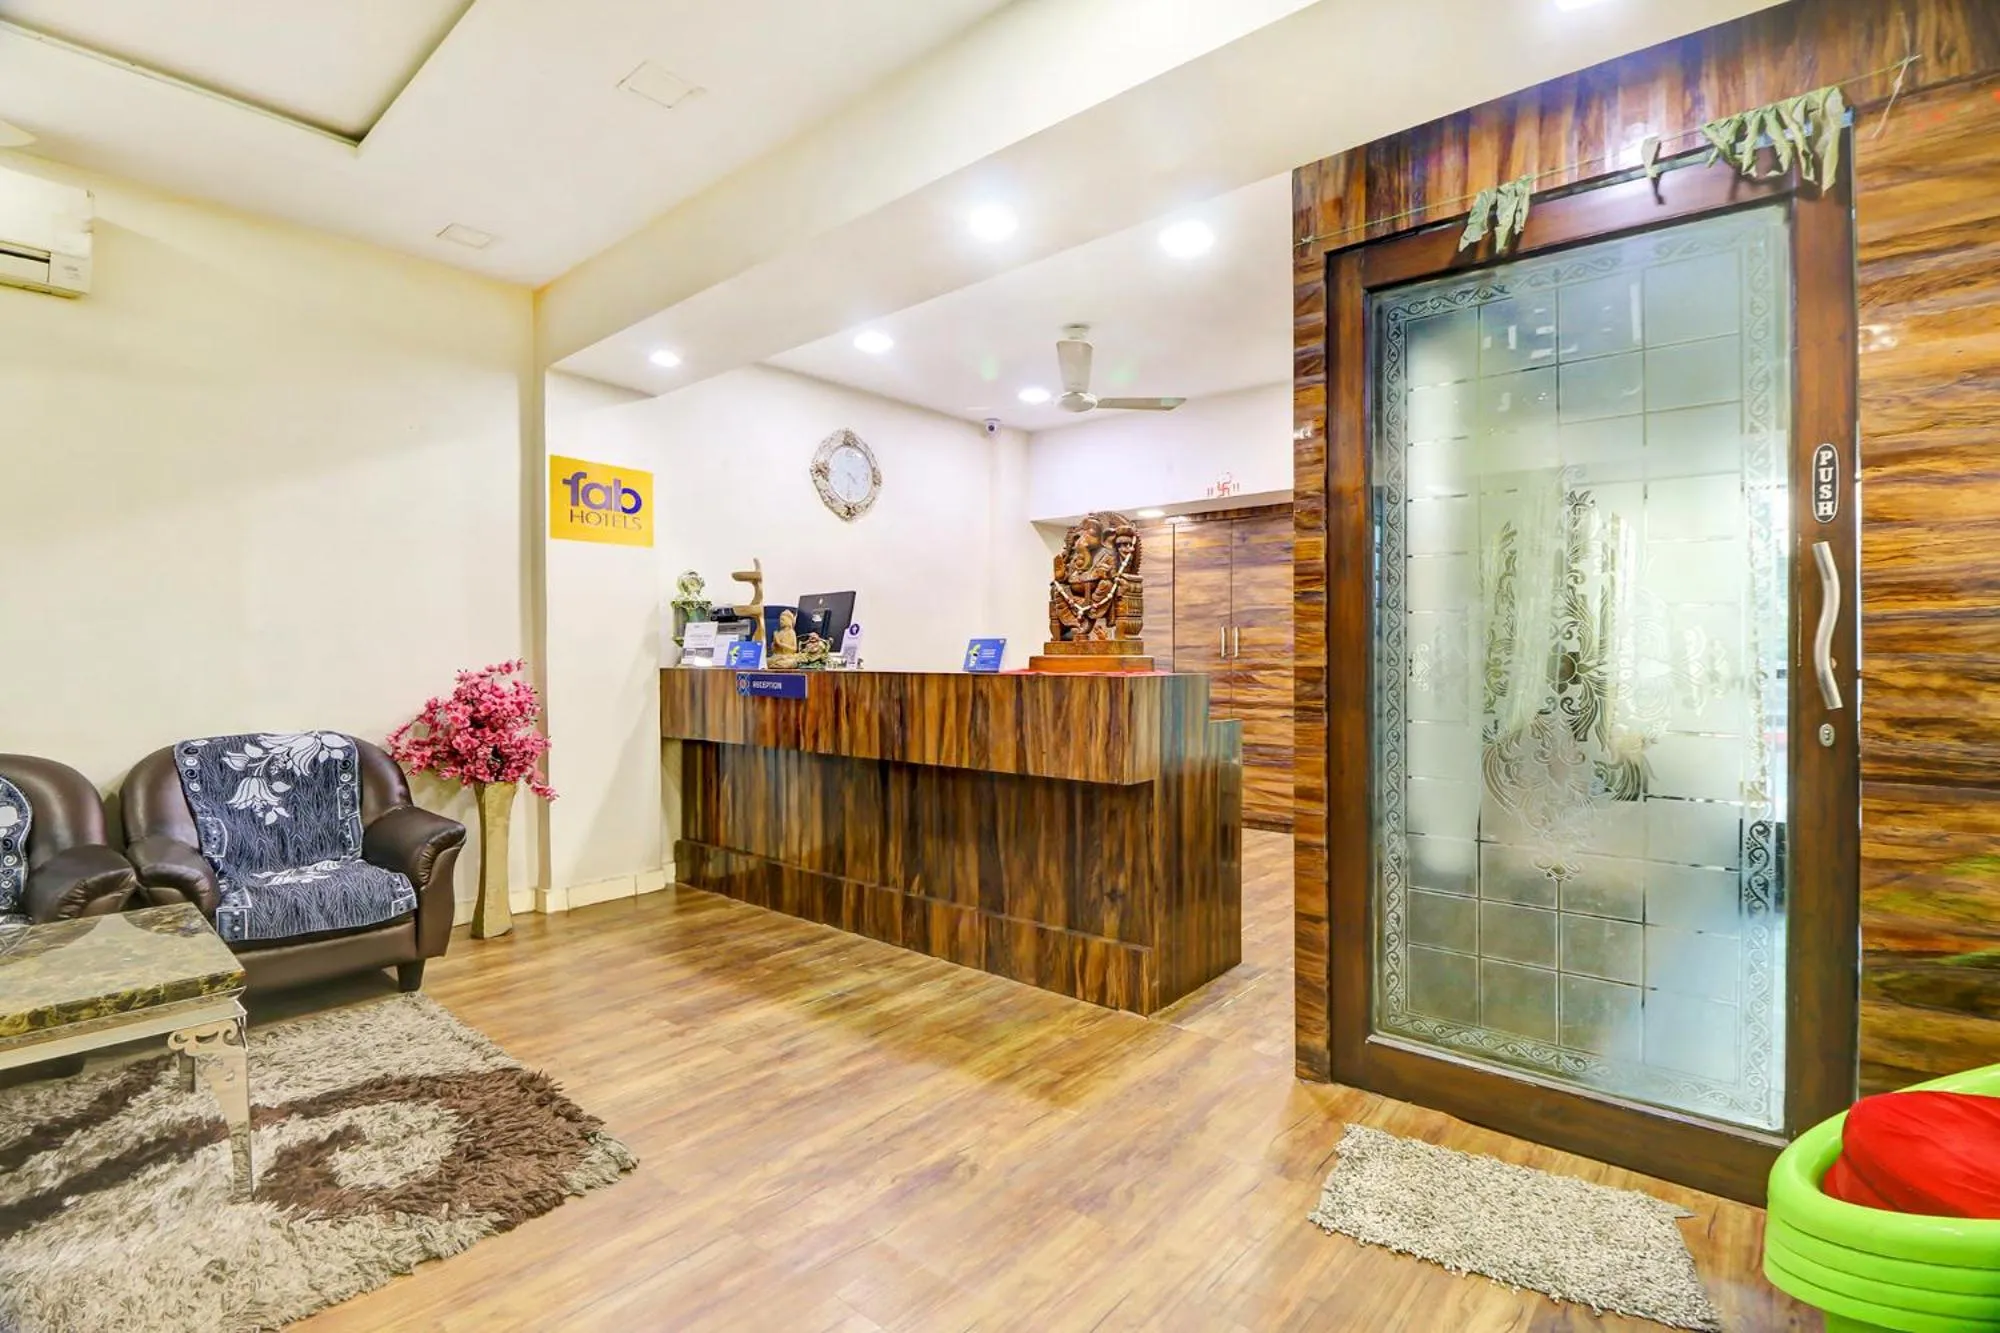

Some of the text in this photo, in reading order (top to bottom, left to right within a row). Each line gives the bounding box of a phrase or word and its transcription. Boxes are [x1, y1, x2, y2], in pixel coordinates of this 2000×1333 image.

[562, 471, 643, 515] fab
[1817, 450, 1835, 516] PUSH
[569, 508, 643, 532] HOTELS
[752, 680, 783, 690] RECEPTION
